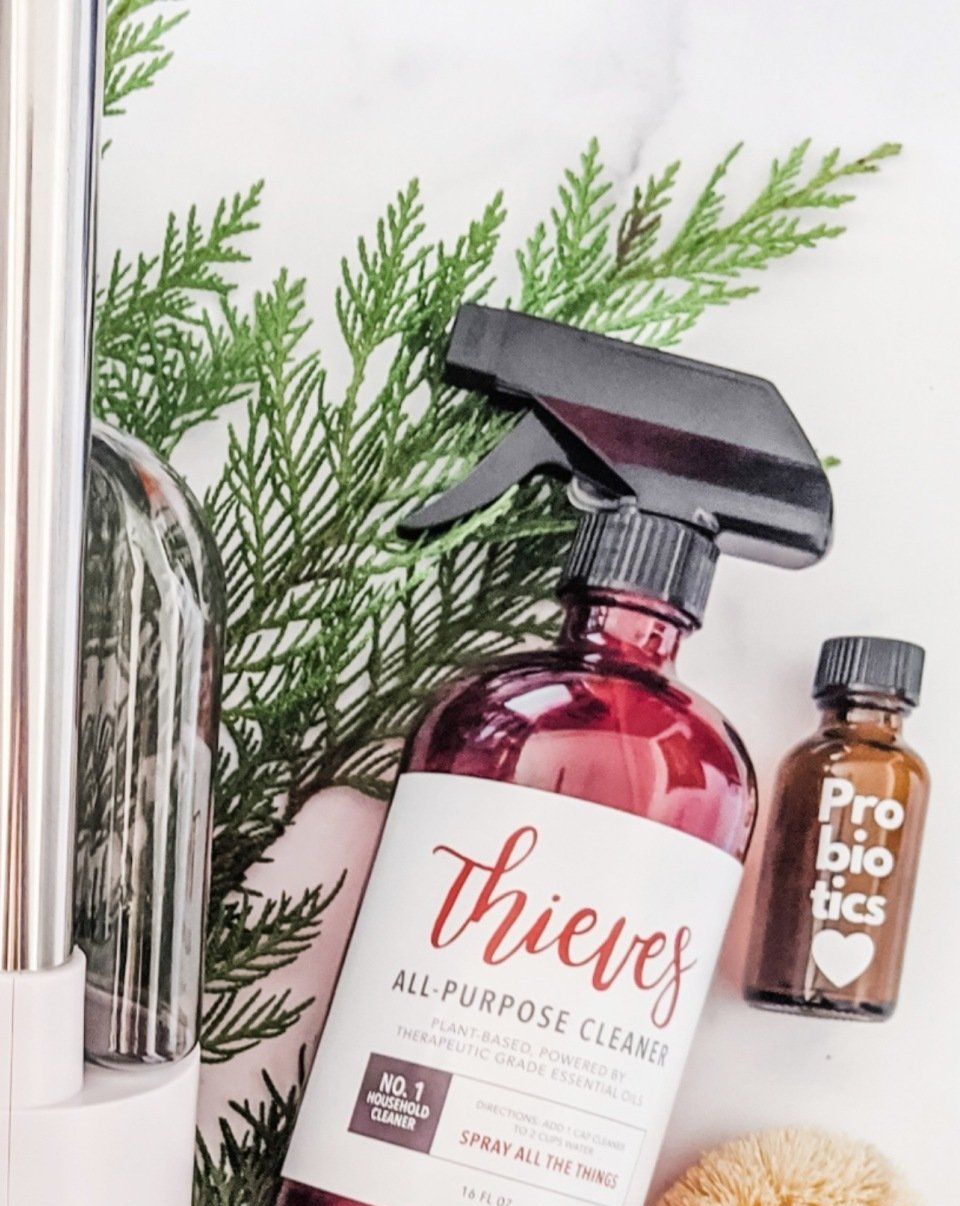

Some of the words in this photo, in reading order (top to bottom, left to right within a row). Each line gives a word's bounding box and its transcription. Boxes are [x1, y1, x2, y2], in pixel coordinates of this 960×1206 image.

[818, 777, 905, 830] Pro
[815, 824, 894, 878] bio
[810, 875, 887, 927] tics
[392, 969, 571, 1034] ALL-PURPOSE
[580, 1018, 670, 1067] CLEANER
[395, 1024, 490, 1061] THERAPEUTIC
[494, 1052, 545, 1077] GRADE
[551, 1069, 620, 1100] ESSENTIAL
[430, 1017, 535, 1058] PLANT-BASED,
[540, 1047, 608, 1078] POWERED
[611, 1068, 627, 1083] BY
[366, 1090, 430, 1120] HOUSEHOLD
[379, 1071, 407, 1098] NO.
[415, 1081, 425, 1101] 1
[370, 1106, 417, 1132] CLEANER
[514, 1123, 528, 1135] TO
[539, 1130, 562, 1147] CUPS
[542, 1118, 564, 1133] ADD
[459, 1130, 511, 1157] SPRAY
[514, 1146, 541, 1167] ALL
[546, 1154, 572, 1176] THE
[576, 1162, 618, 1190] THINGS
[461, 1185, 476, 1200] 16
[480, 1190, 492, 1204] FL
